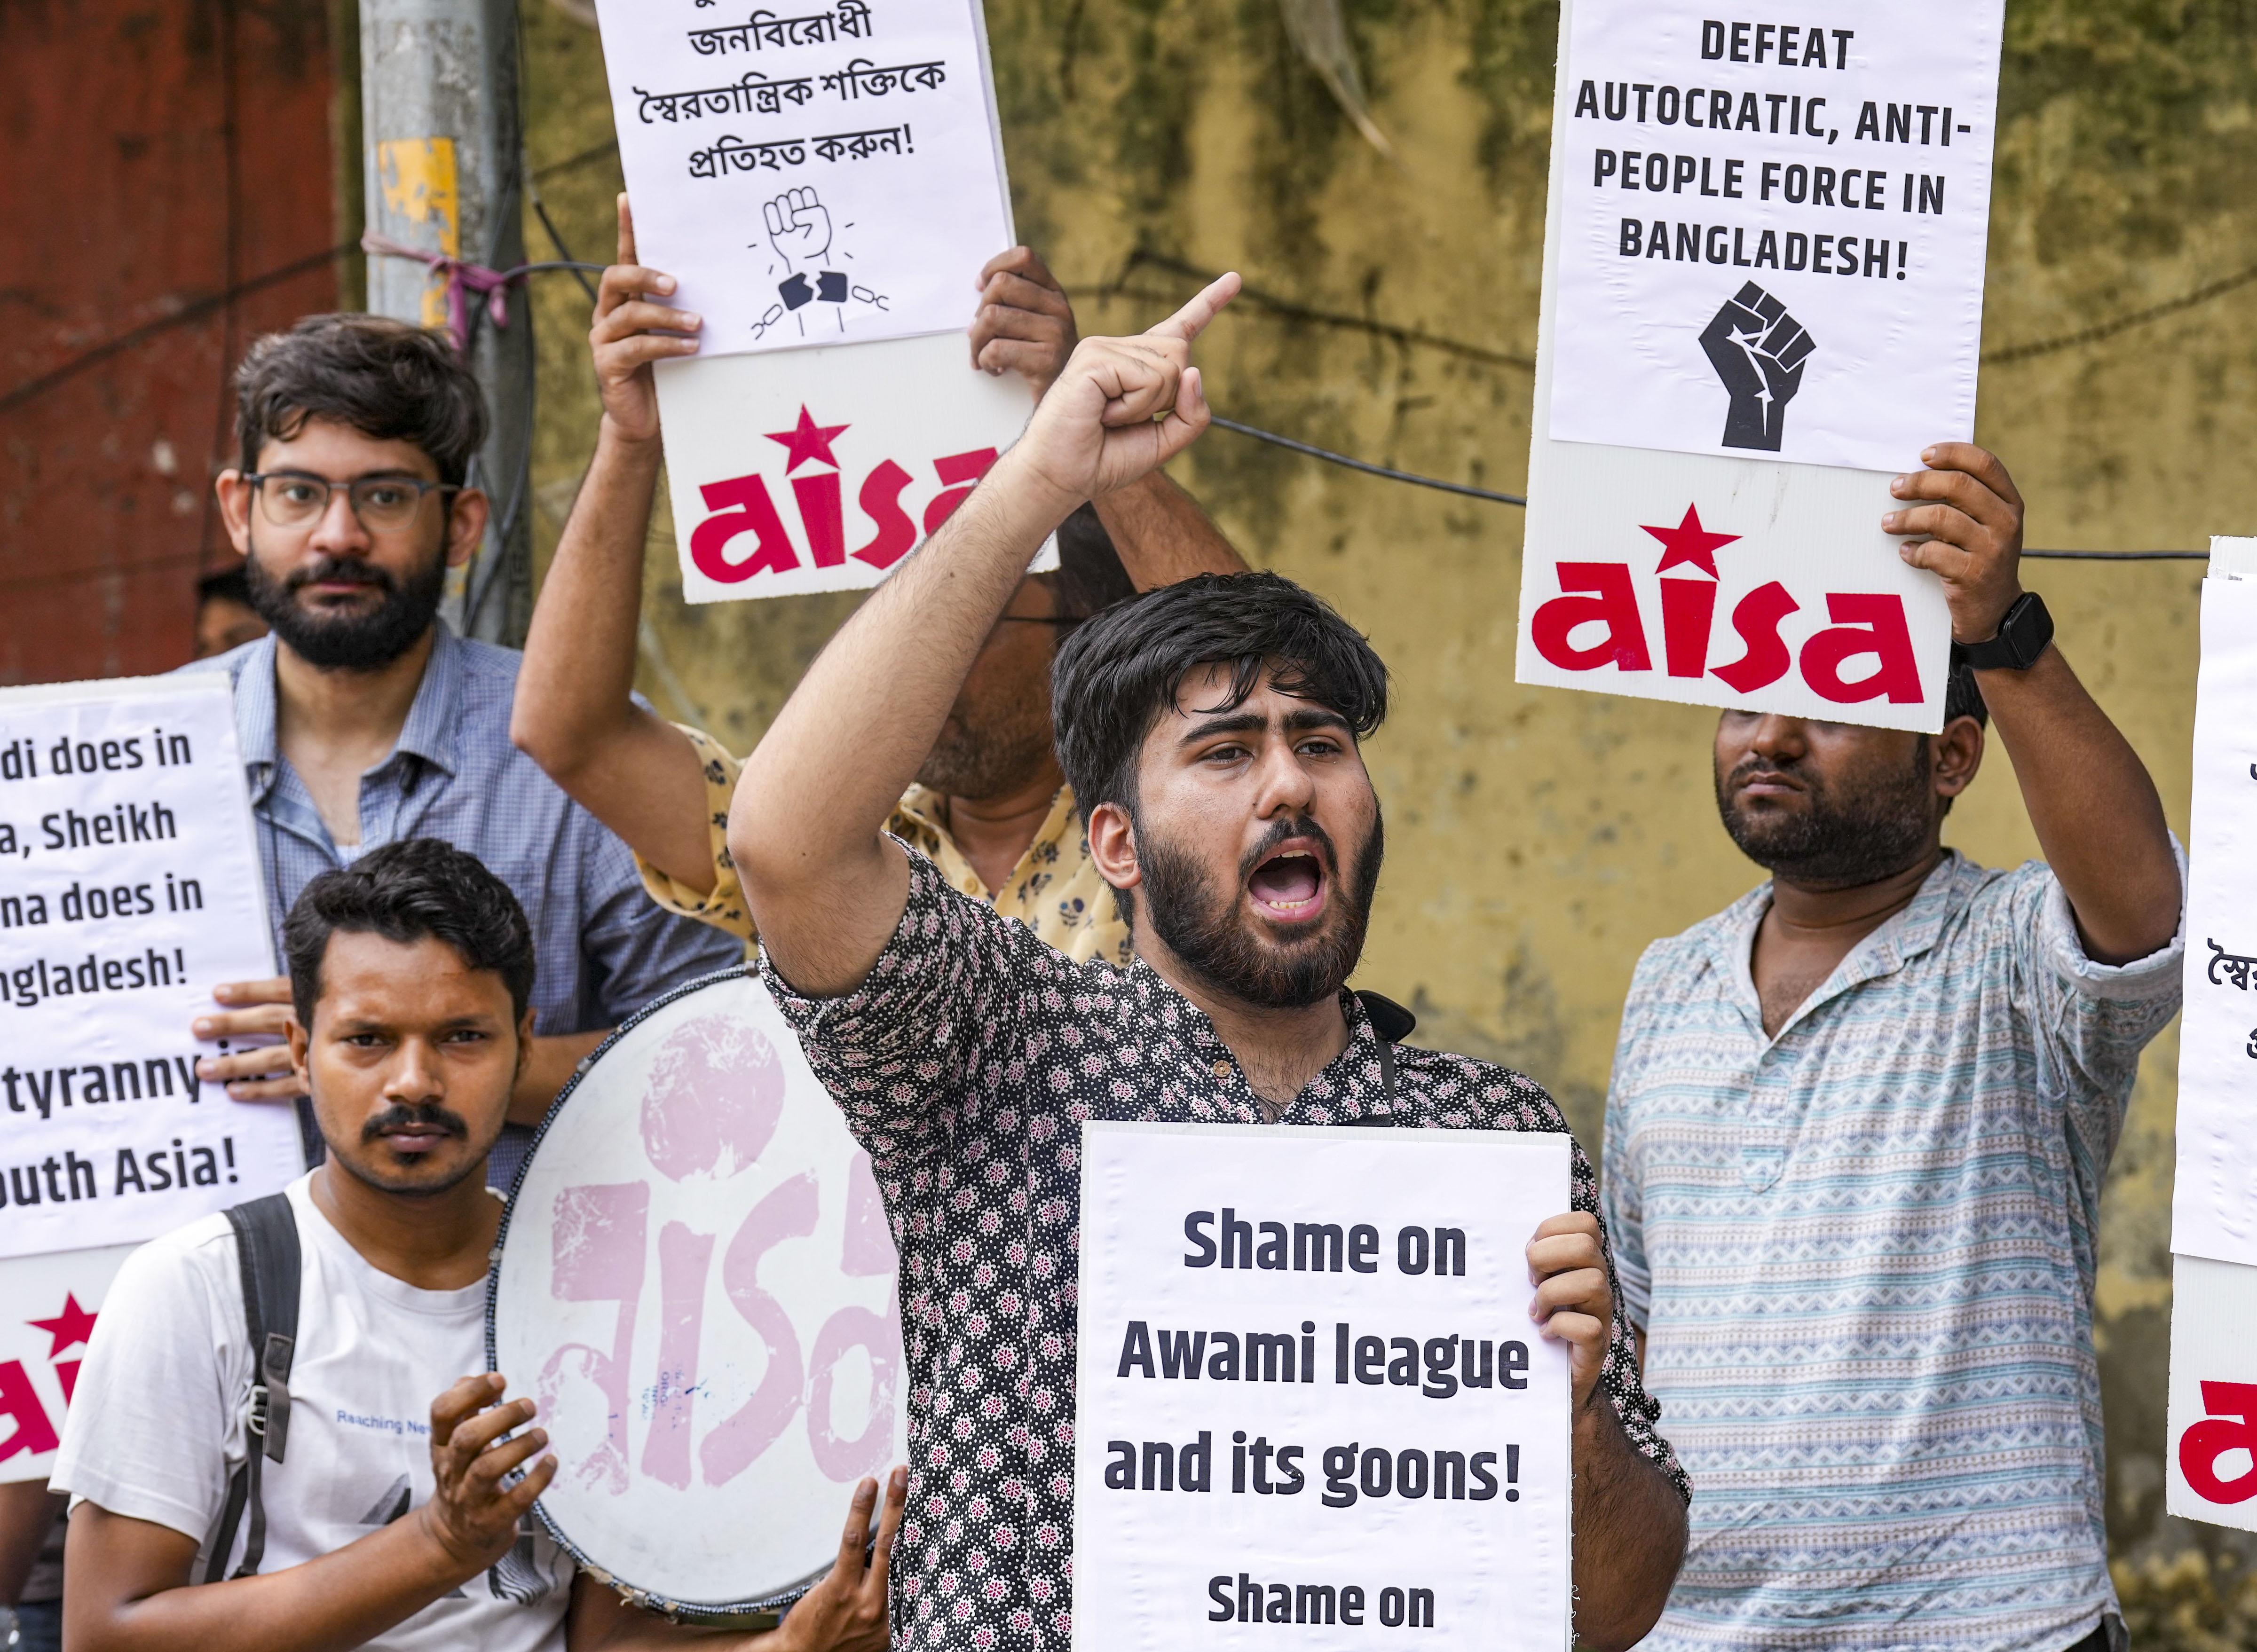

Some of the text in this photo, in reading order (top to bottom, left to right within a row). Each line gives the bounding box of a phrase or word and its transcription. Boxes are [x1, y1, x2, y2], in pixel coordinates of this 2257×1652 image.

[687, 0, 872, 55] জনবিরোধী
[1701, 19, 1855, 71] DEFEAT
[632, 58, 946, 124] স্বৈরতান্ত্রিক শক্তিকে
[1574, 79, 1971, 147] AUTOCRATIC, ANTI-
[689, 123, 914, 179] প্রতিহত করুন!
[1594, 148, 1945, 215] PEOPLE FORCE IN
[1619, 217, 1908, 281] BANGLADESH!
[1531, 503, 1925, 704] aisa
[50, 737, 143, 775] does
[154, 728, 192, 766] in
[41, 802, 176, 850] Sheikh
[61, 882, 155, 922] does
[166, 873, 203, 912] in
[3, 1054, 202, 1119] tyranny
[0, 1137, 238, 1210] uth Asia!
[1184, 1207, 1466, 1277] Shame on
[1116, 1320, 1530, 1400] Awami league
[1104, 1430, 1520, 1509] and its goons!
[1208, 1572, 1435, 1628] Shame on
